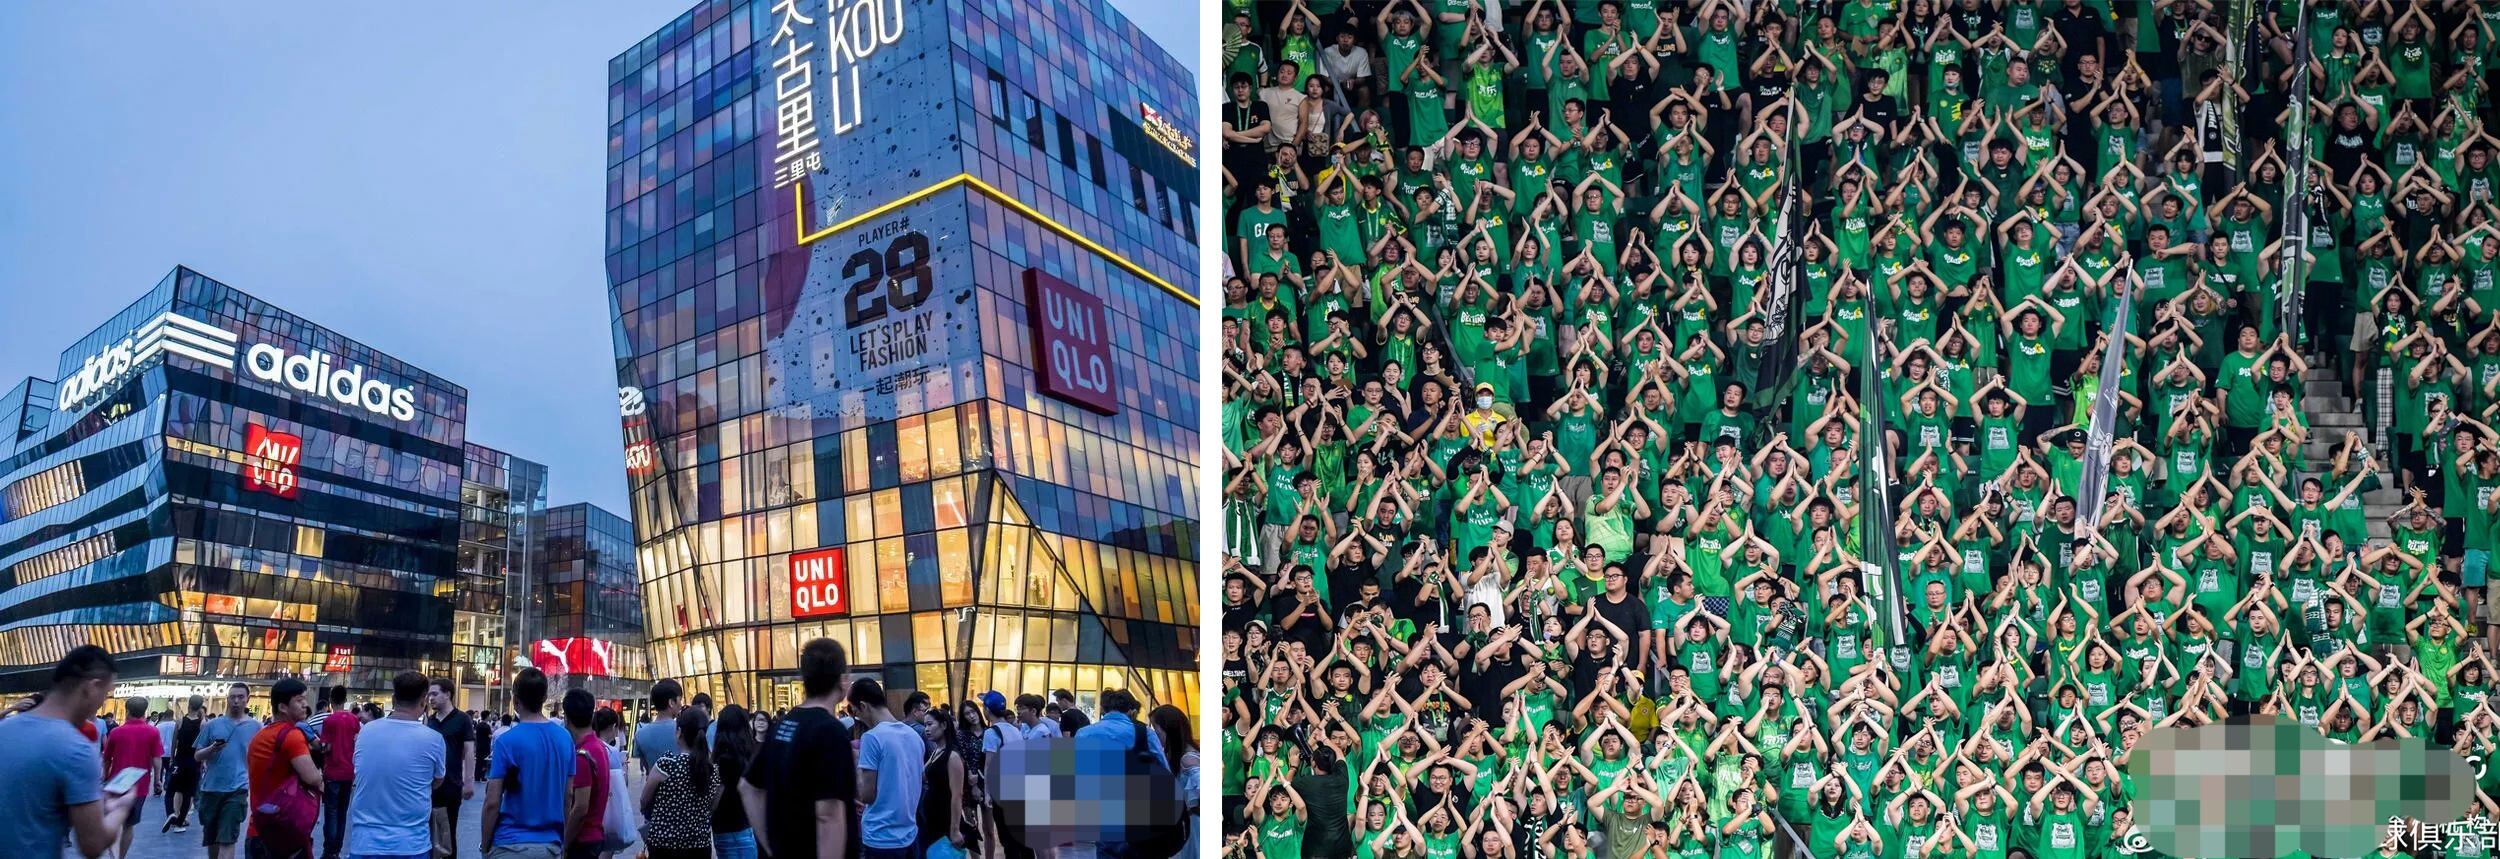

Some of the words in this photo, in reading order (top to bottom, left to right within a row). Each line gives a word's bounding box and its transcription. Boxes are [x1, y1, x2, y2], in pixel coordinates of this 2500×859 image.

[832, 65, 862, 135] LI
[773, 151, 822, 189] 三里屯
[842, 231, 934, 331] 28
[893, 310, 933, 345] PLAY
[1045, 287, 1097, 346] UNI
[60, 337, 134, 412] adidas
[859, 333, 928, 373] FASHION
[1052, 339, 1108, 394] QLO
[247, 342, 416, 422] adidas
[860, 365, 932, 397] 一起潮玩
[794, 556, 834, 582] UNI
[796, 583, 839, 613] QLO
